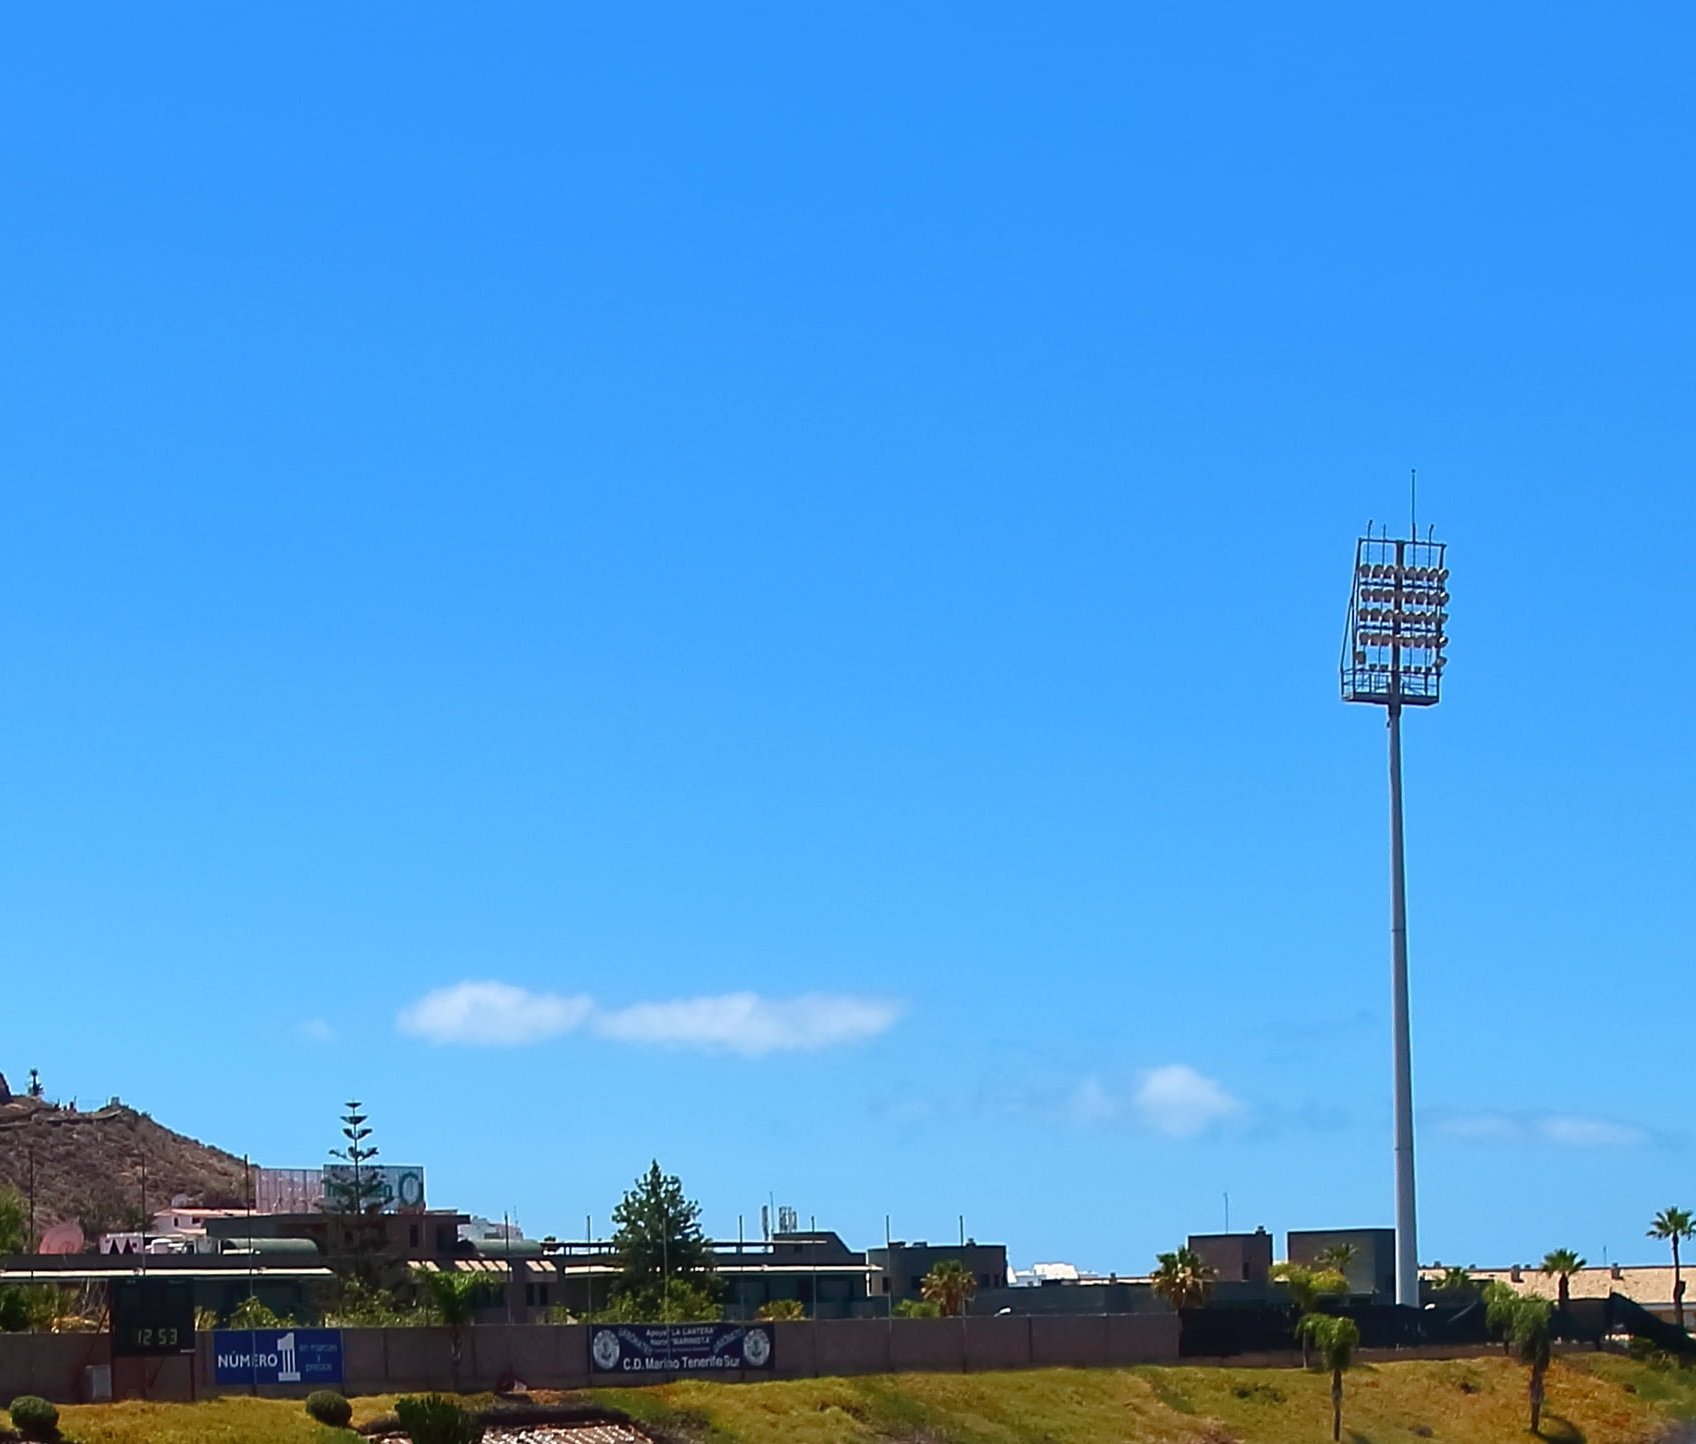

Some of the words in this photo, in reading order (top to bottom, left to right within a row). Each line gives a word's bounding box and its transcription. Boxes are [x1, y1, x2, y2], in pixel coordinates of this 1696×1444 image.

[217, 1350, 278, 1368] NÚMERO
[277, 1332, 301, 1381] 1
[681, 1356, 723, 1369] Tenerife
[724, 1355, 740, 1367] Sur
